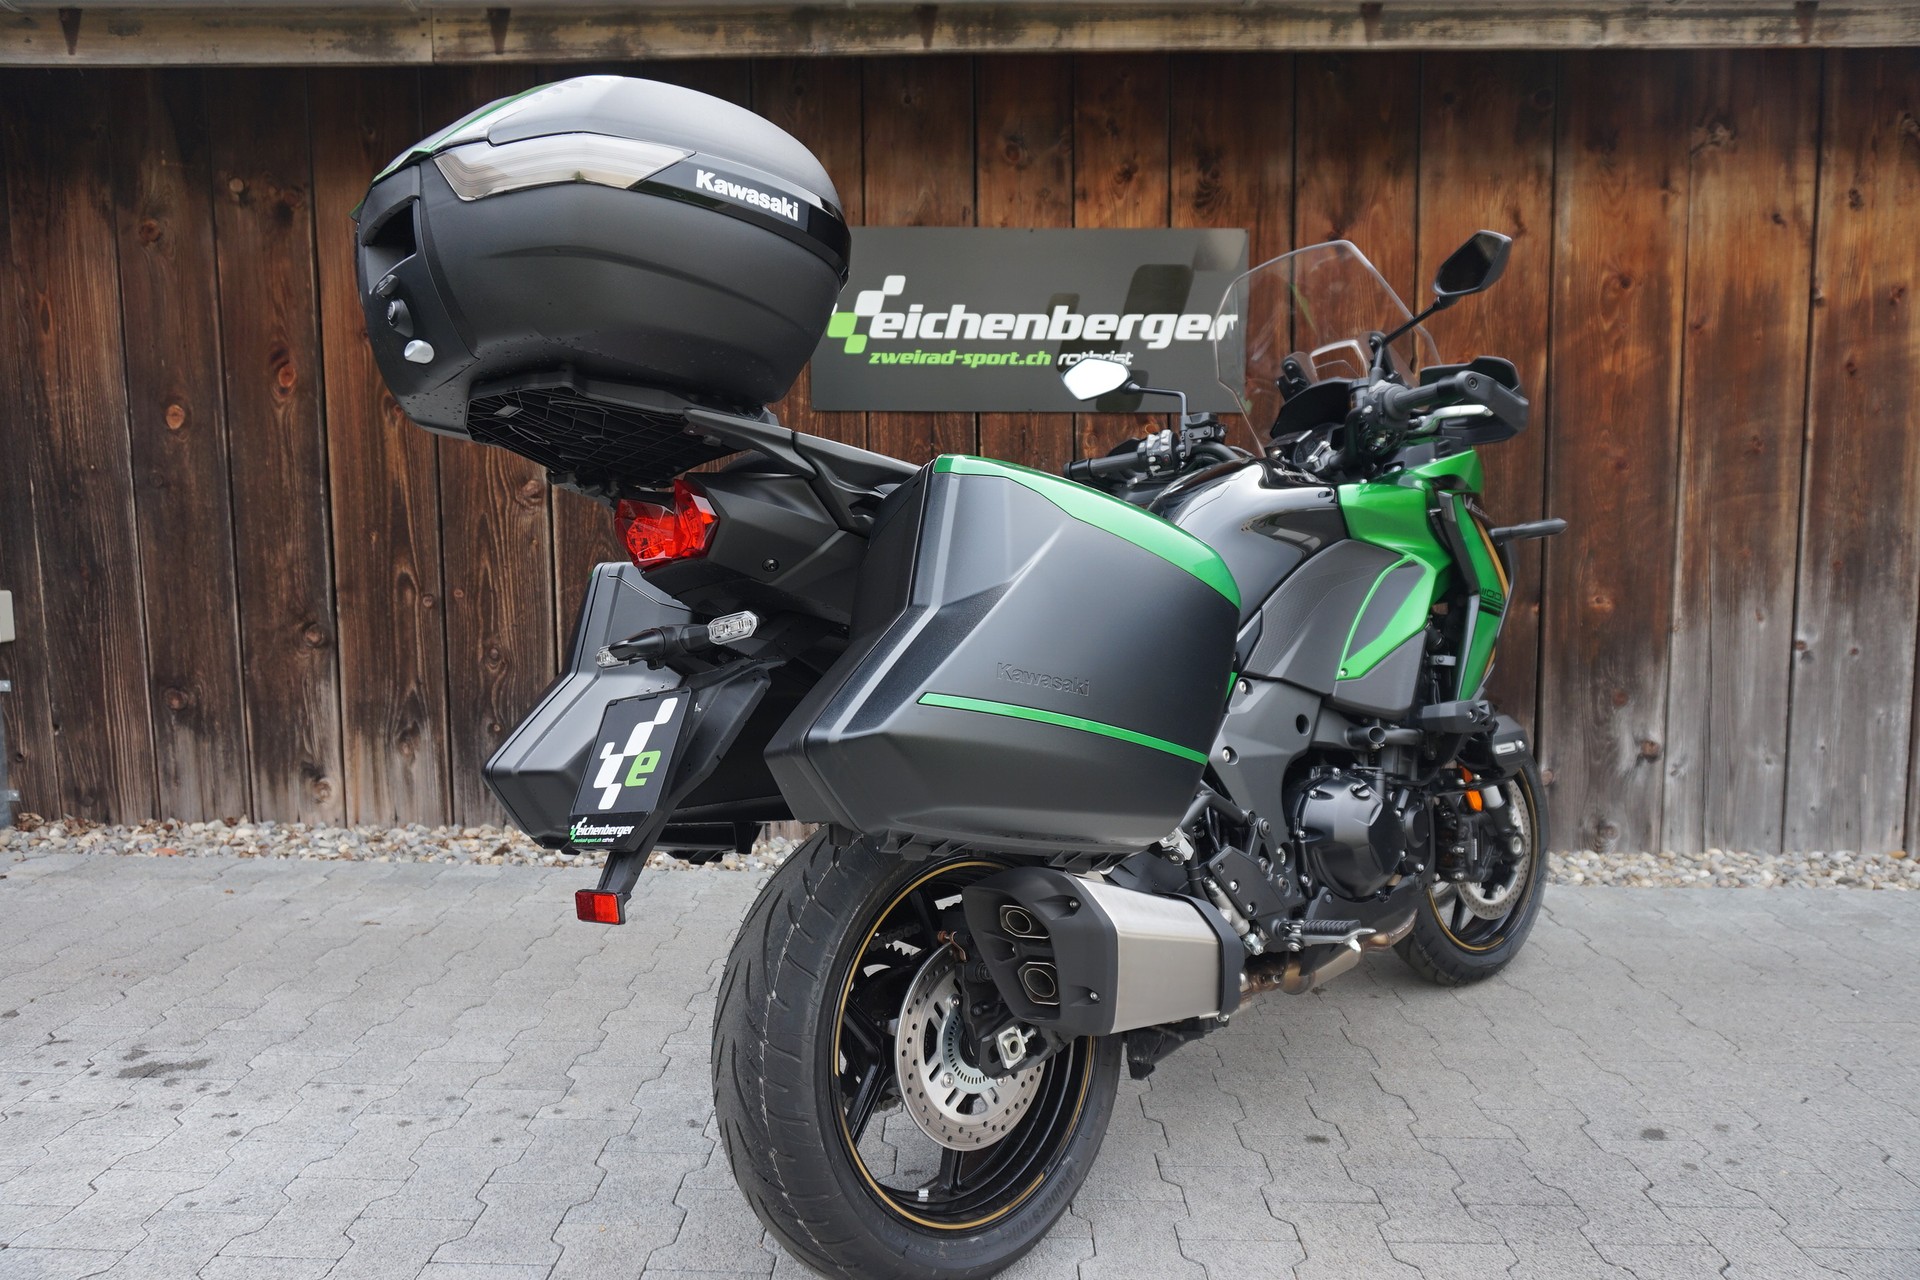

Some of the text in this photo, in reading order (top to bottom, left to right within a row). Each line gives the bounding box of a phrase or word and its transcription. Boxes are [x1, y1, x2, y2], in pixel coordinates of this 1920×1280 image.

[695, 169, 799, 222] Kawasaki
[869, 304, 1239, 350] eichenberger
[869, 350, 1052, 368] zweirad-sport.ch
[996, 662, 1090, 697] Kawasaki
[624, 750, 662, 787] e
[575, 824, 635, 838] eichenberger
